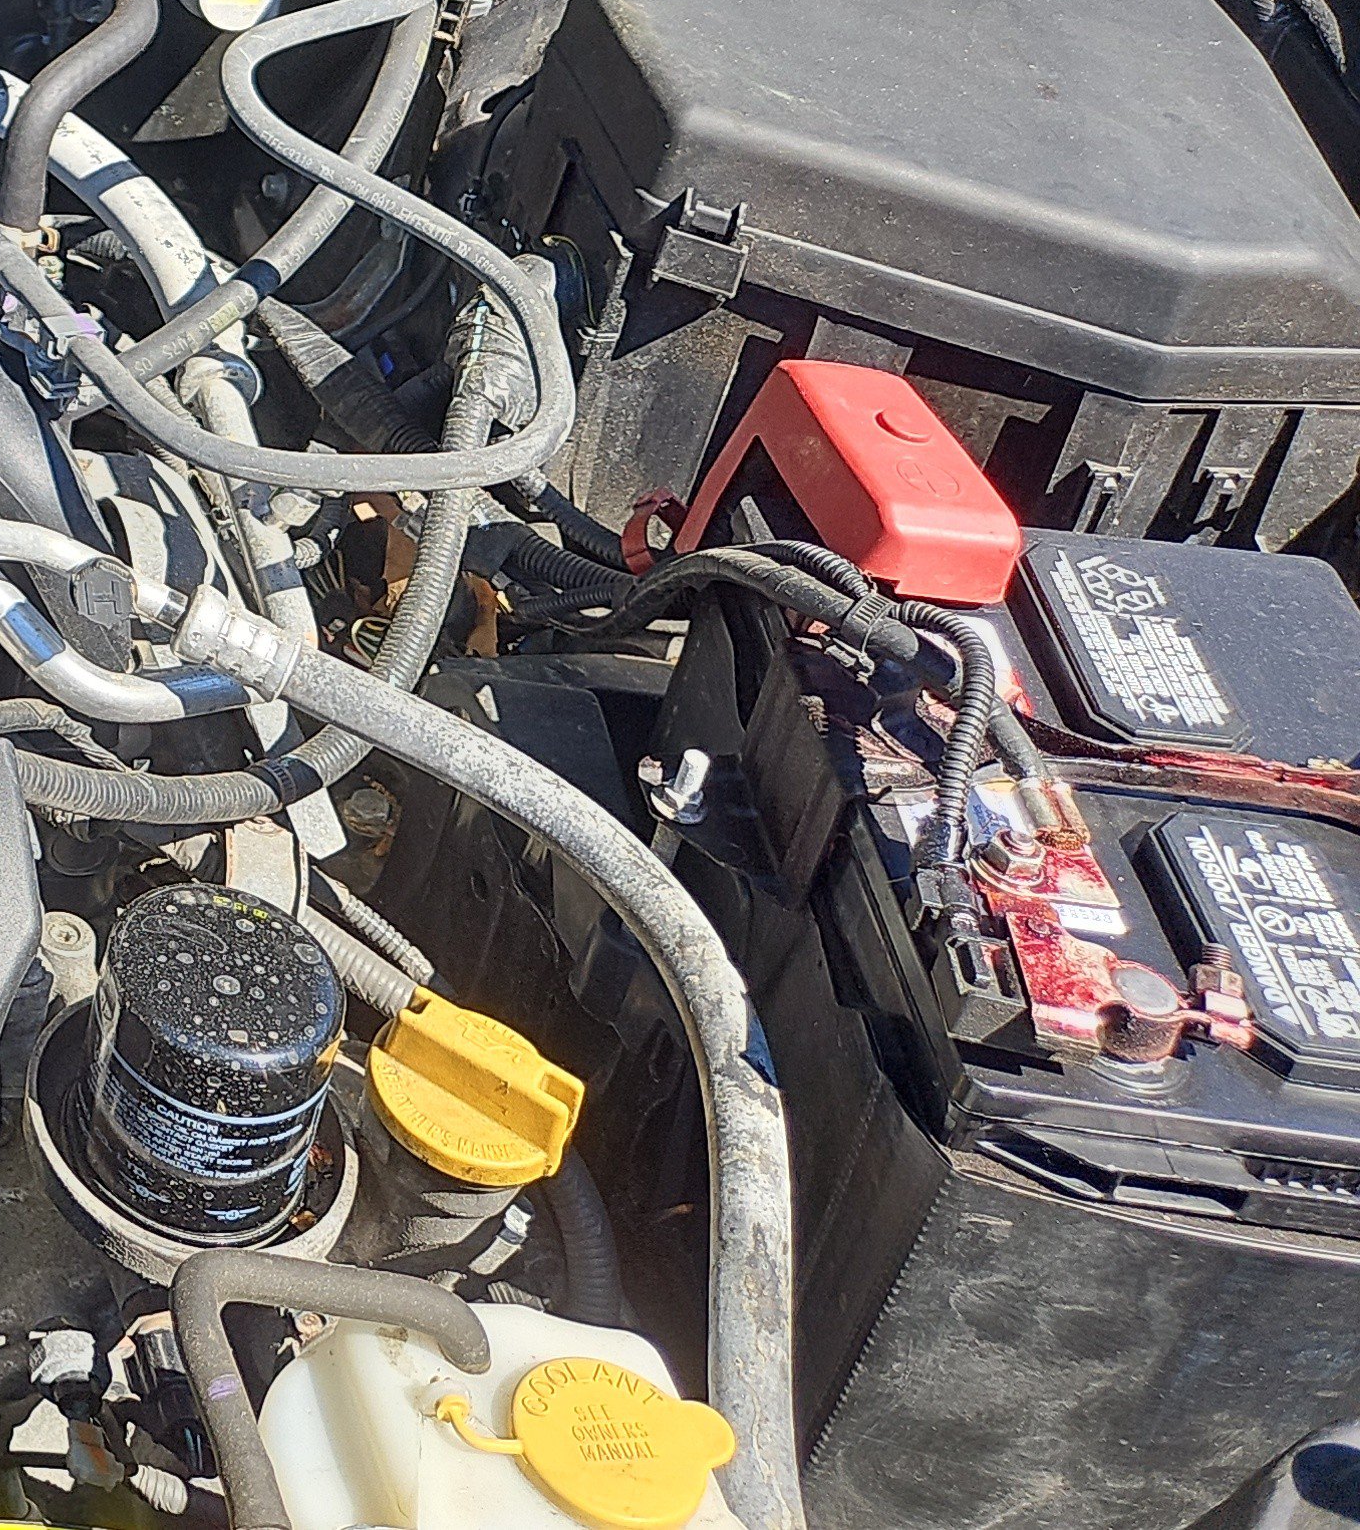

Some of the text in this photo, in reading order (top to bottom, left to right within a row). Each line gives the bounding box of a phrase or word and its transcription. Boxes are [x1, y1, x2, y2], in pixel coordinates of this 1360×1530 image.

[1183, 836, 1238, 904] POISON
[1292, 917, 1315, 935] NO
[1227, 923, 1291, 1004] DANGER
[156, 1104, 219, 1135] CAUTION
[521, 1362, 664, 1417] COOLANT
[573, 1404, 615, 1422] SEE
[571, 1422, 649, 1442] OWNERS
[579, 1441, 659, 1463] MANUAL
